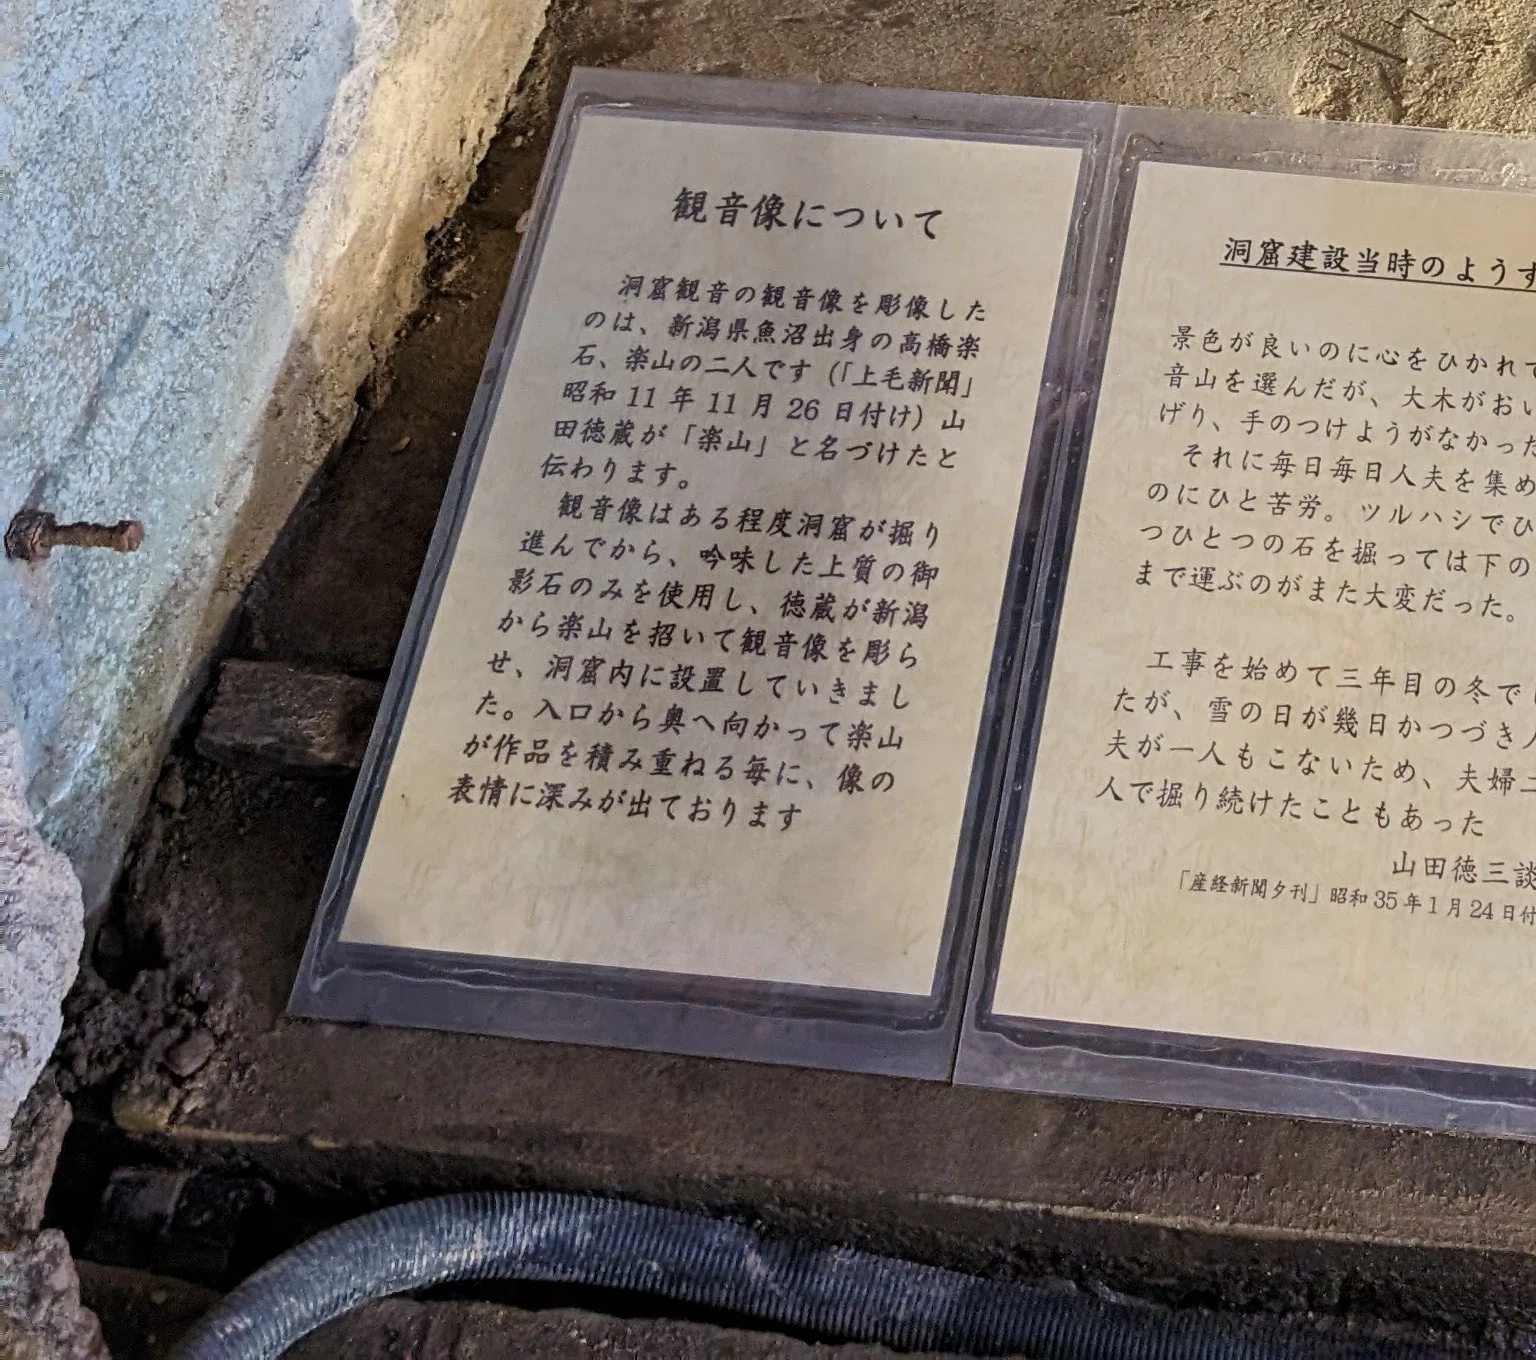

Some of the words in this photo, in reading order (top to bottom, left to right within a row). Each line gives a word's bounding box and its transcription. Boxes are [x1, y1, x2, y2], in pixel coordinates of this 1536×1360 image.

[672, 187, 942, 239] 観音像について
[541, 453, 688, 490] 伝わります。
